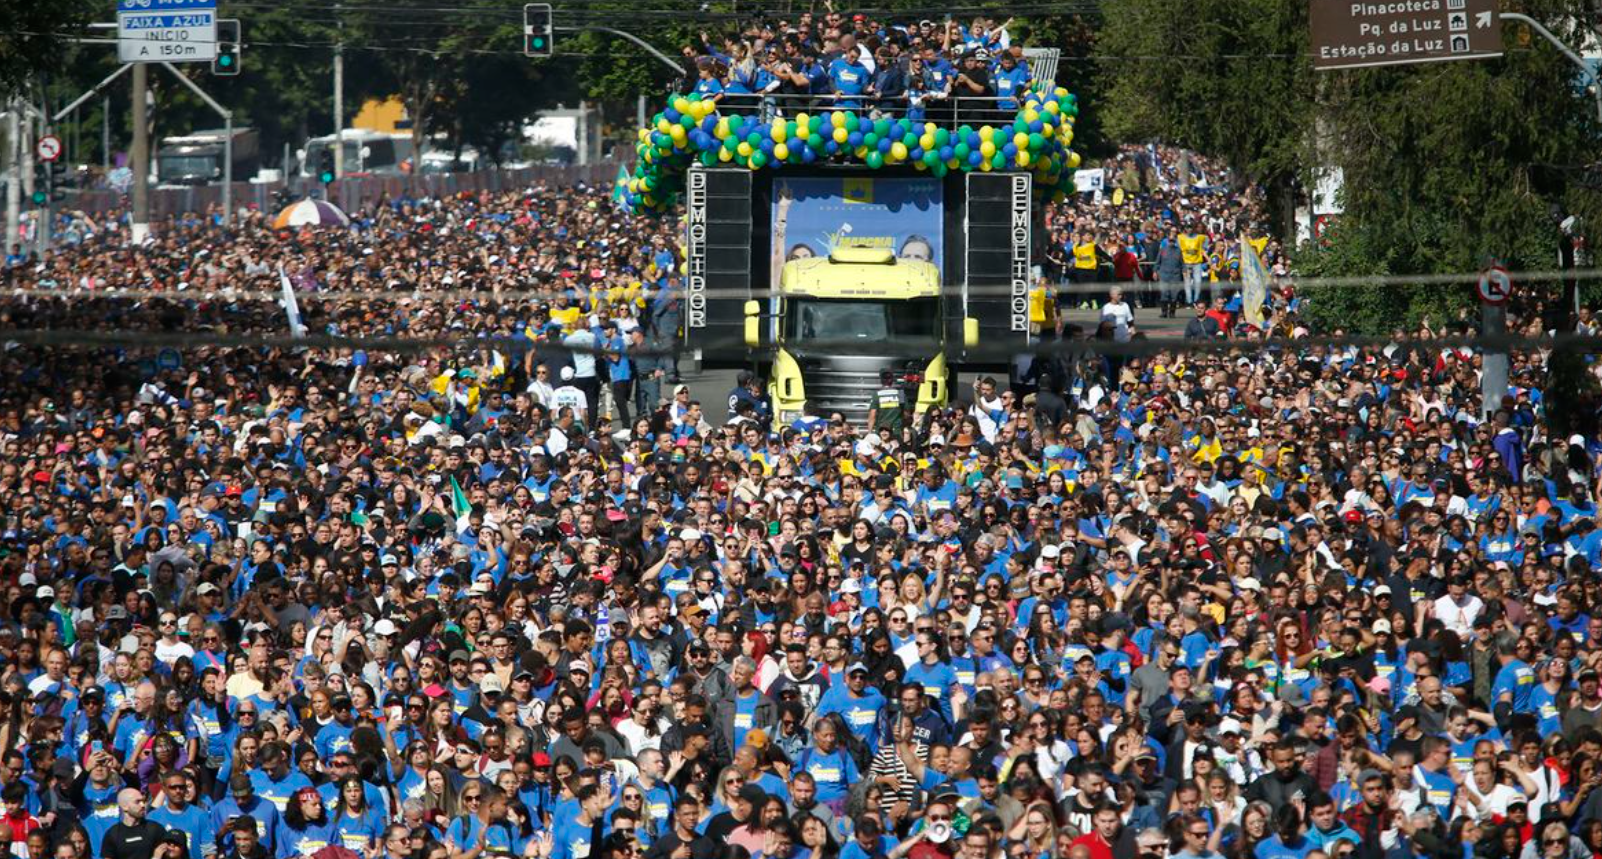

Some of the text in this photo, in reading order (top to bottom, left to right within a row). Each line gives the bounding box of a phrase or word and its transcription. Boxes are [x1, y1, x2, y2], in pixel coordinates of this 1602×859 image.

[1351, 0, 1440, 16] Pinacoteca
[125, 14, 211, 28] FAIXA AZUL
[1360, 18, 1442, 37] Pq. da Luz
[140, 44, 196, 55] A 150m
[1320, 38, 1444, 59] Estação da Luz
[690, 173, 706, 327] DEMOLIDOR
[1012, 176, 1028, 331] DEMOLIDOR
